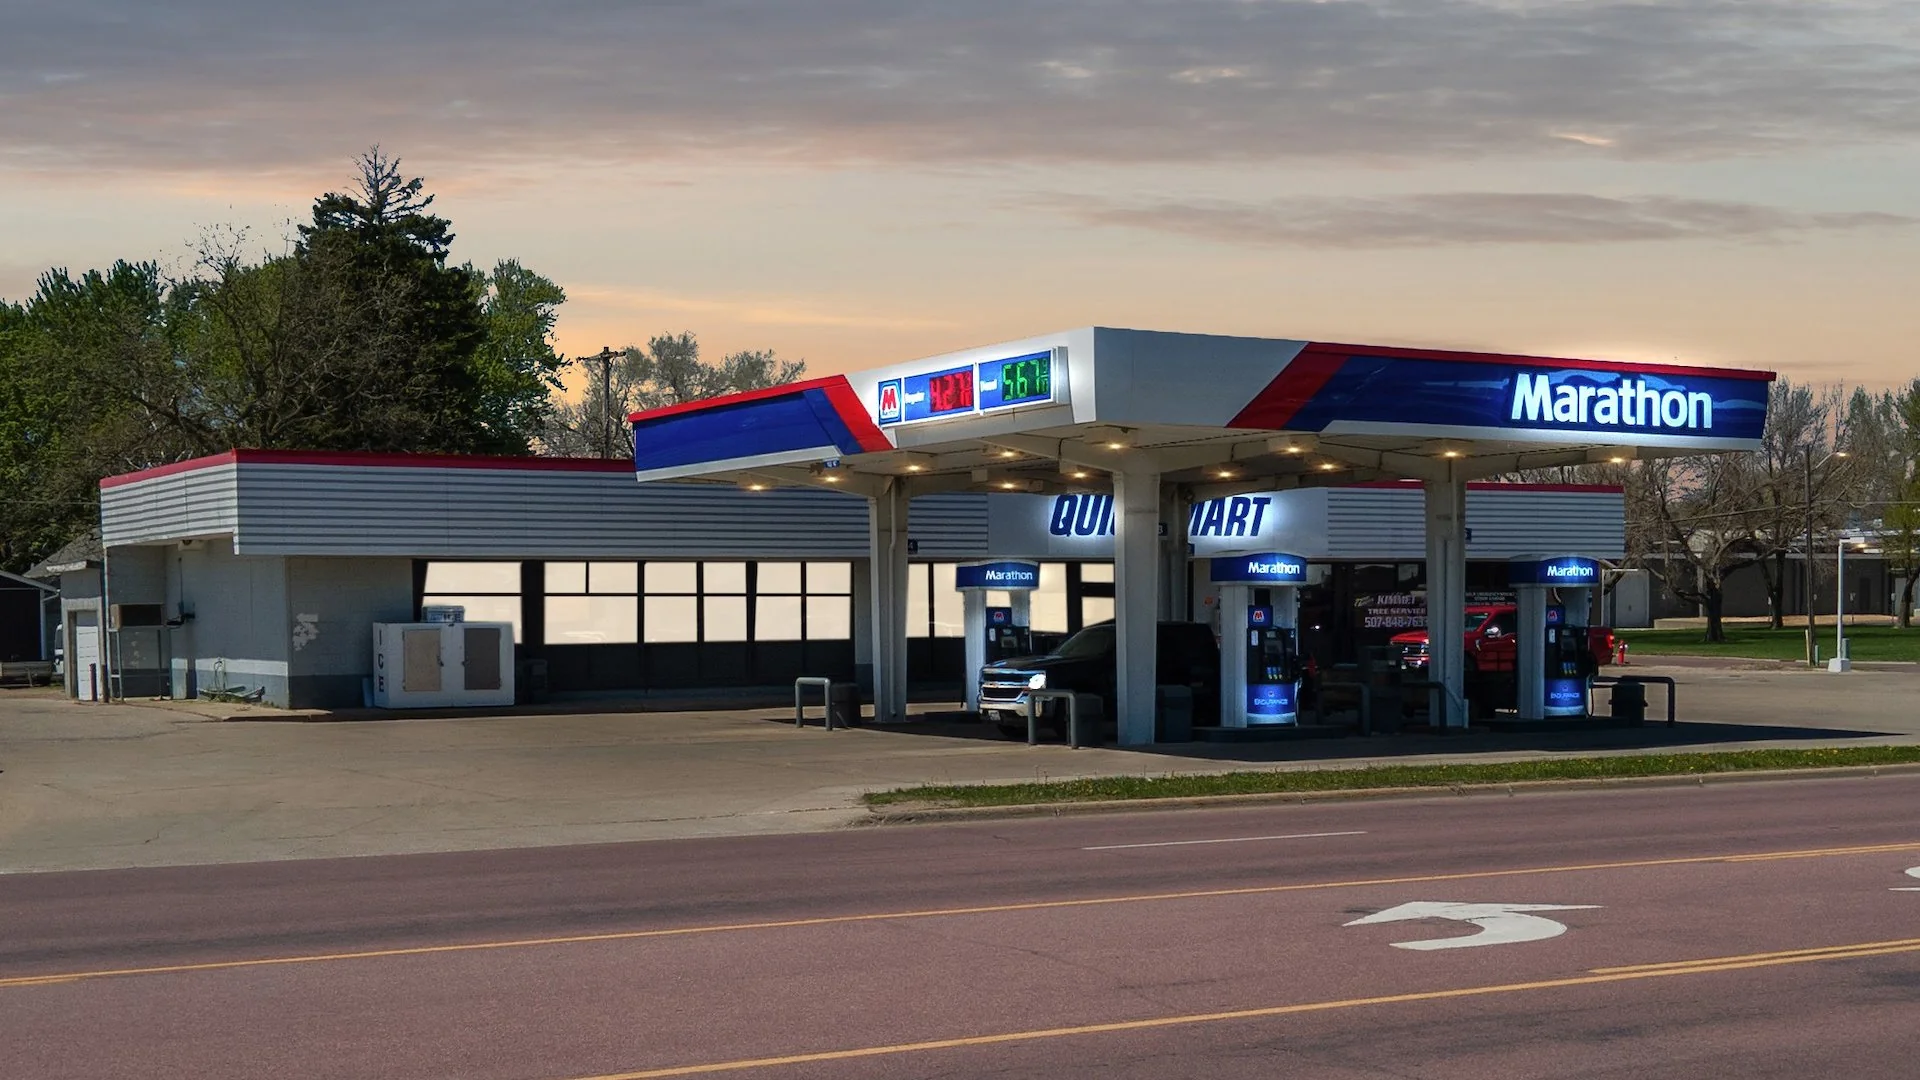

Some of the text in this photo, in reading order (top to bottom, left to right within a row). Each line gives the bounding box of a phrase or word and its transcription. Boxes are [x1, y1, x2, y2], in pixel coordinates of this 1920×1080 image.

[882, 389, 897, 411] M
[1511, 373, 1713, 429] Marathon
[1050, 494, 1114, 537] QUI
[985, 570, 1033, 581] Marathon
[1247, 561, 1300, 575] Marathon
[1547, 565, 1593, 577] Marathon
